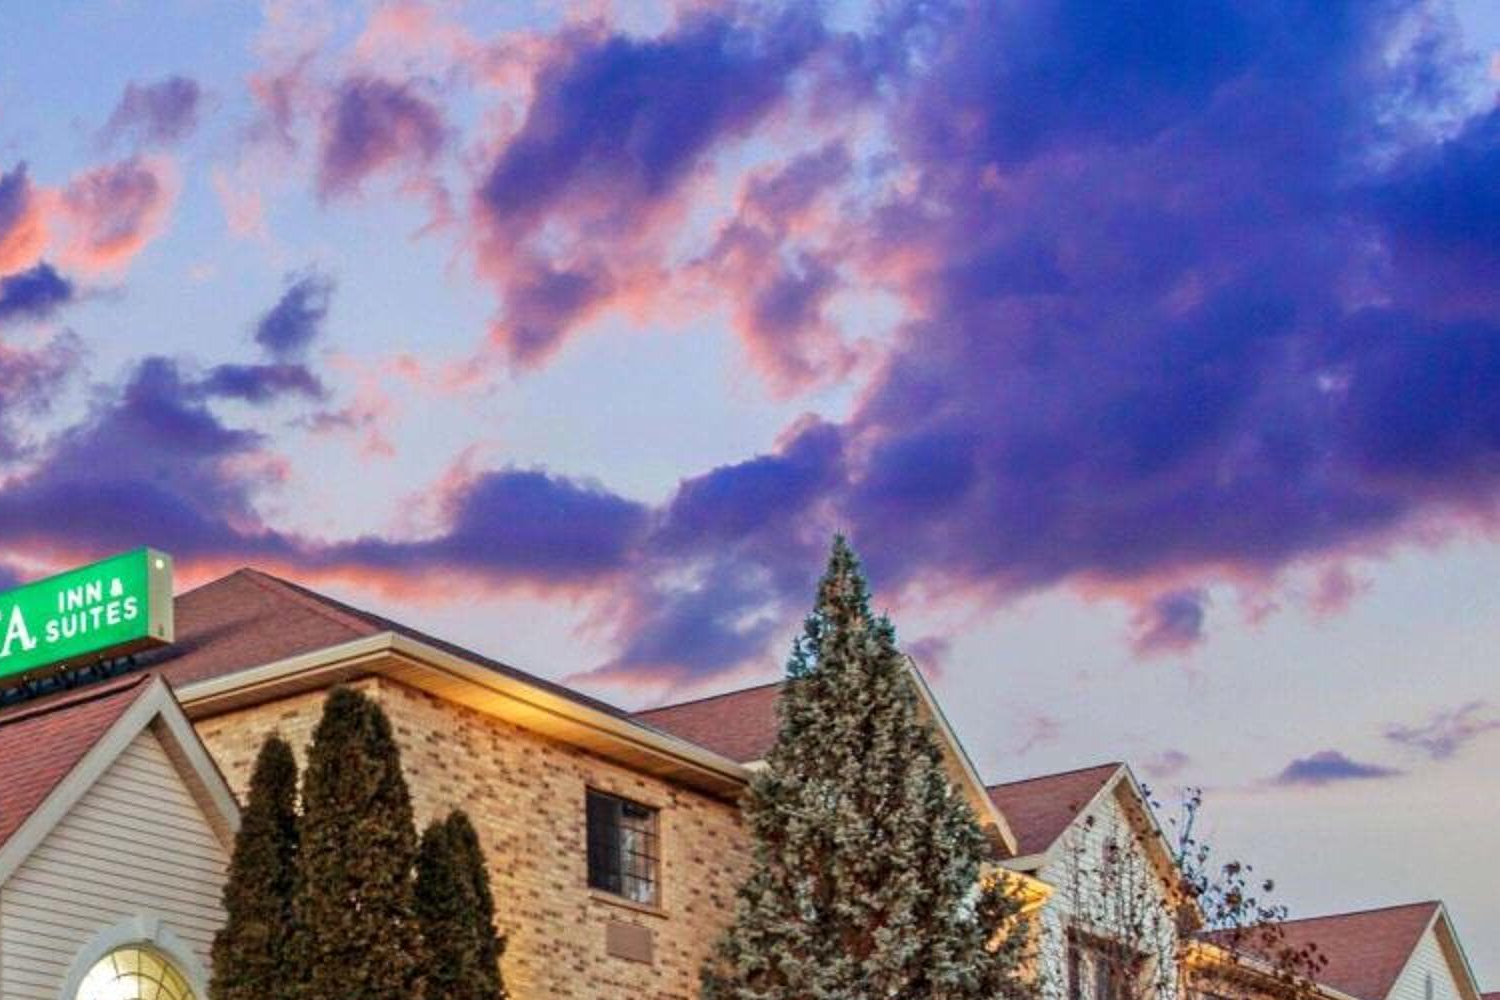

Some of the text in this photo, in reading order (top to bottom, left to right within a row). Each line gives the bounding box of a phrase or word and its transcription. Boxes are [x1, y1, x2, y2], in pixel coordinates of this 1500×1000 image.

[58, 578, 124, 611] INN &
[46, 597, 138, 643] SUITES
